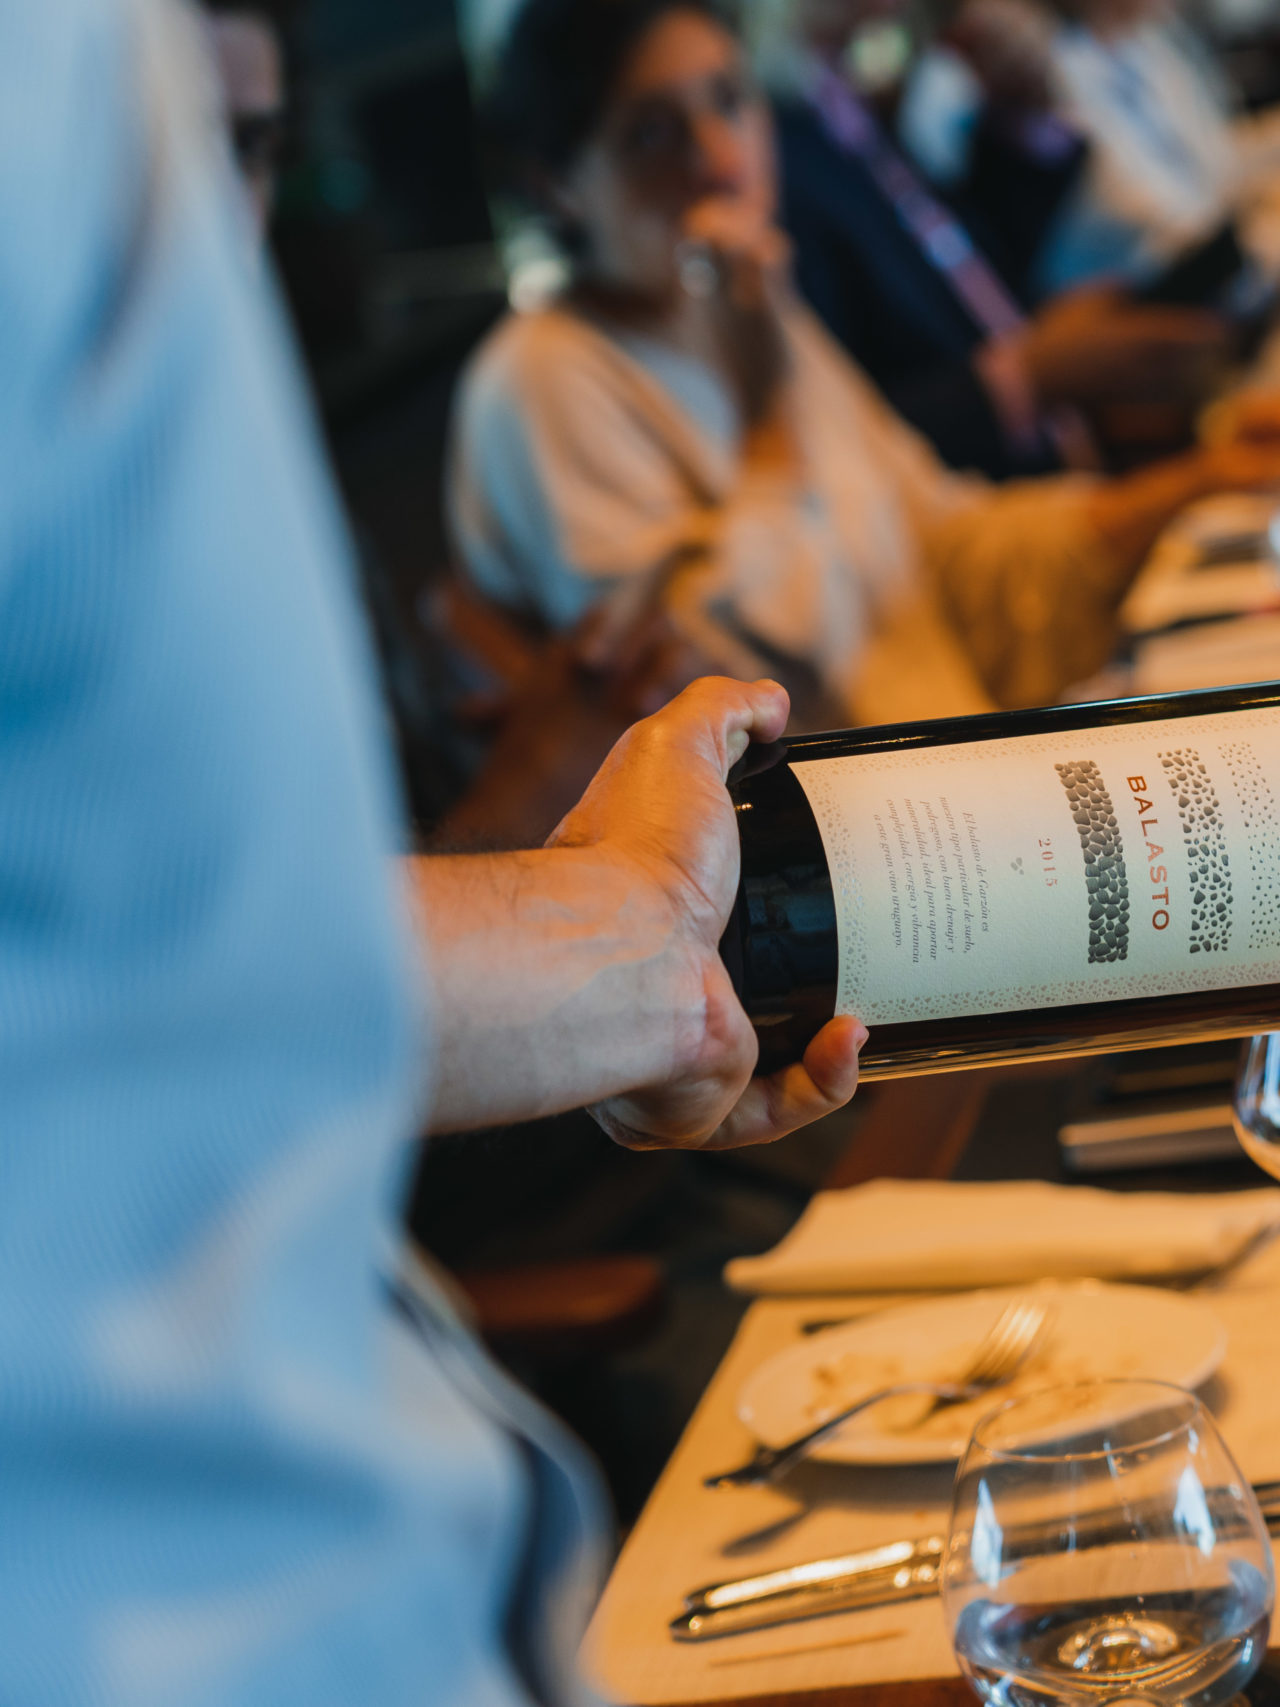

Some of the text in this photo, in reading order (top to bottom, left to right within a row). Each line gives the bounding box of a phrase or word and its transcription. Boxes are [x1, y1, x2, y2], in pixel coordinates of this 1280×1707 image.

[877, 823, 888, 841] este
[879, 842, 895, 867] gran
[939, 855, 947, 872] con
[1039, 837, 1058, 887] 2015
[1127, 775, 1170, 931] BALASTO
[888, 871, 898, 892] vino
[922, 862, 936, 889] ideal
[939, 796, 975, 954] nuestro tipo particular de suelo,
[942, 876, 952, 900] buen
[962, 812, 990, 932] El balasto de Garzón es
[923, 890, 936, 916] para
[891, 896, 903, 948] uruguayo.
[912, 914, 922, 963] vibrancia
[945, 904, 956, 943] drenaje
[927, 920, 937, 960] aportar
[946, 945, 955, 953] y
